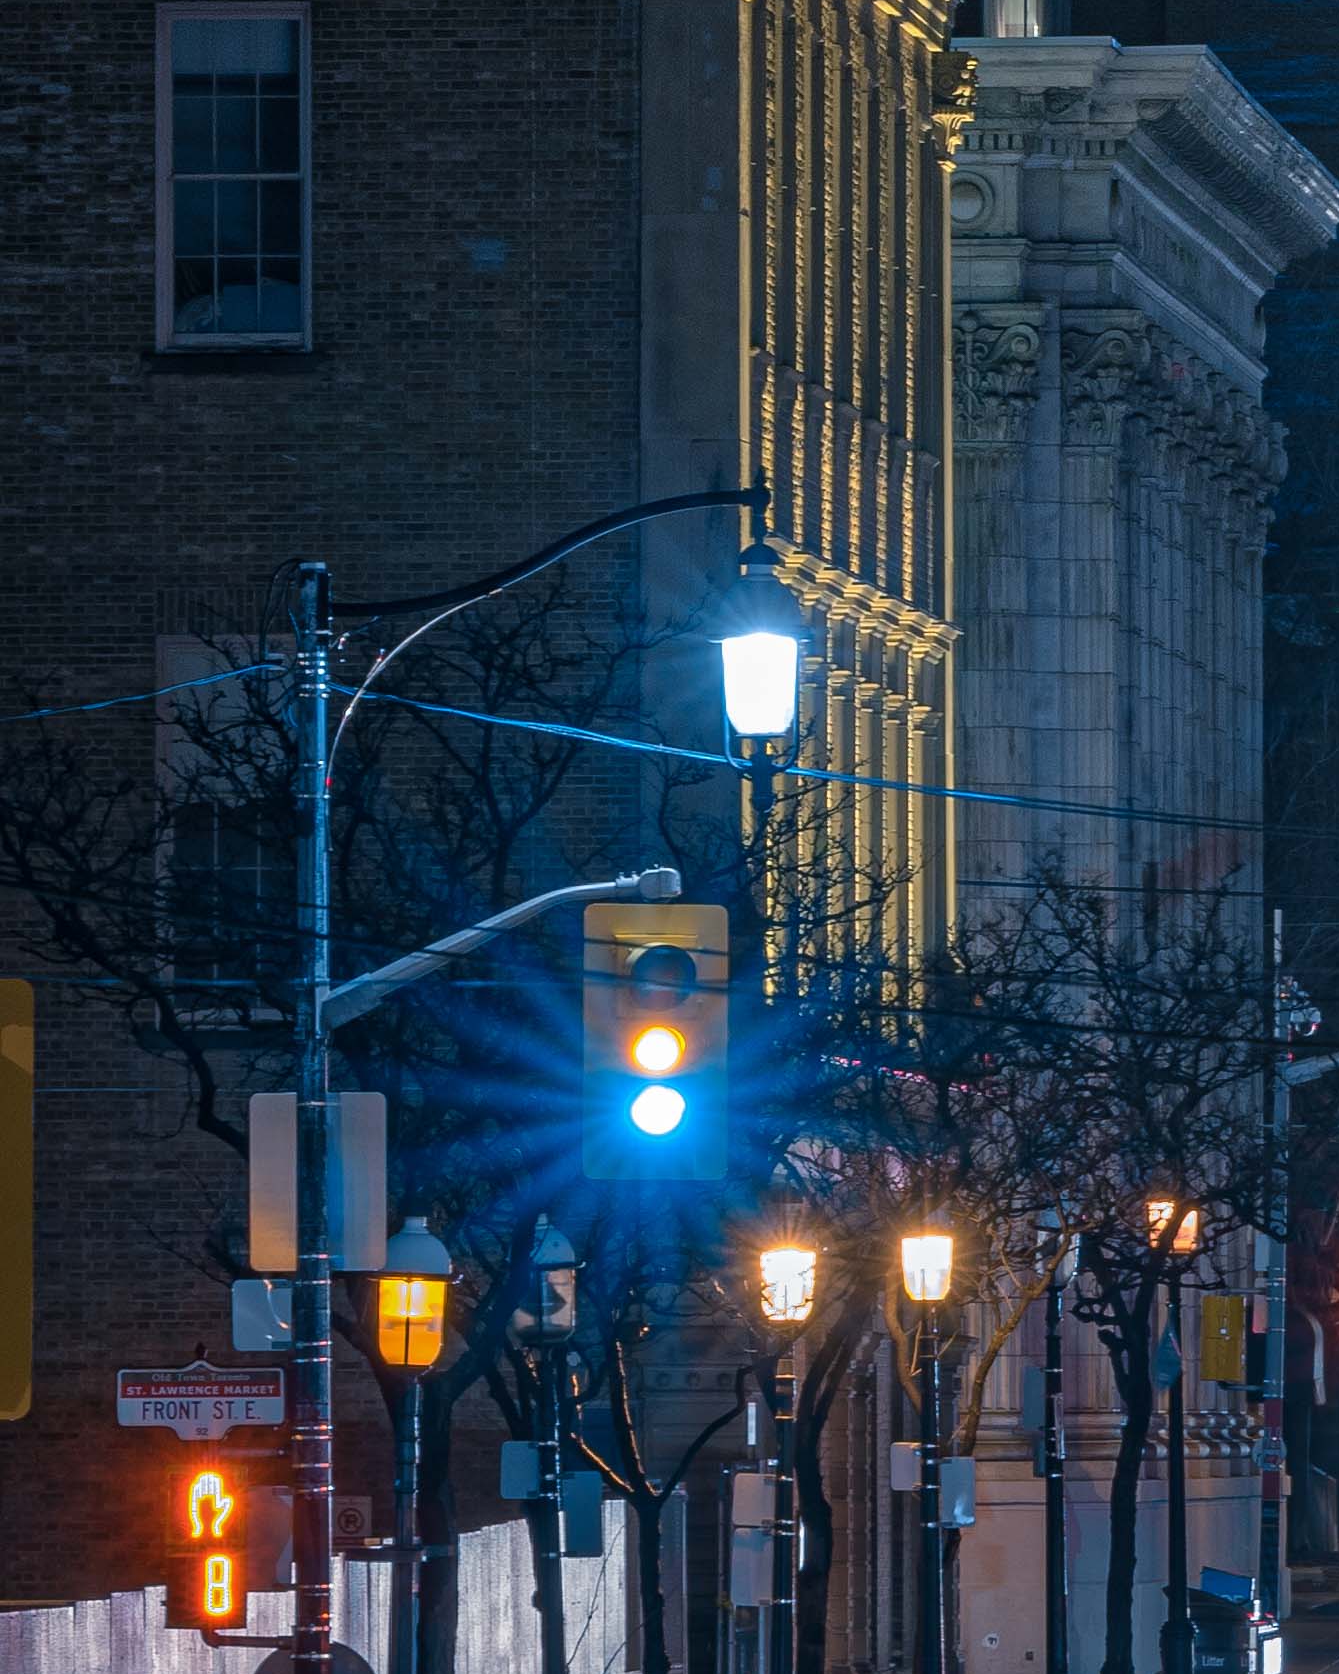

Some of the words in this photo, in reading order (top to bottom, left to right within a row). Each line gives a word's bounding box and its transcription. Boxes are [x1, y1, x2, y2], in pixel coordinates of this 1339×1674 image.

[152, 1373, 171, 1381] Old
[126, 1386, 147, 1395] ST.
[152, 1385, 220, 1395] LAWRENCE
[223, 1385, 275, 1394] MARKET
[142, 1401, 201, 1420] FRONT
[213, 1401, 238, 1420] ST.
[245, 1401, 261, 1420] E.
